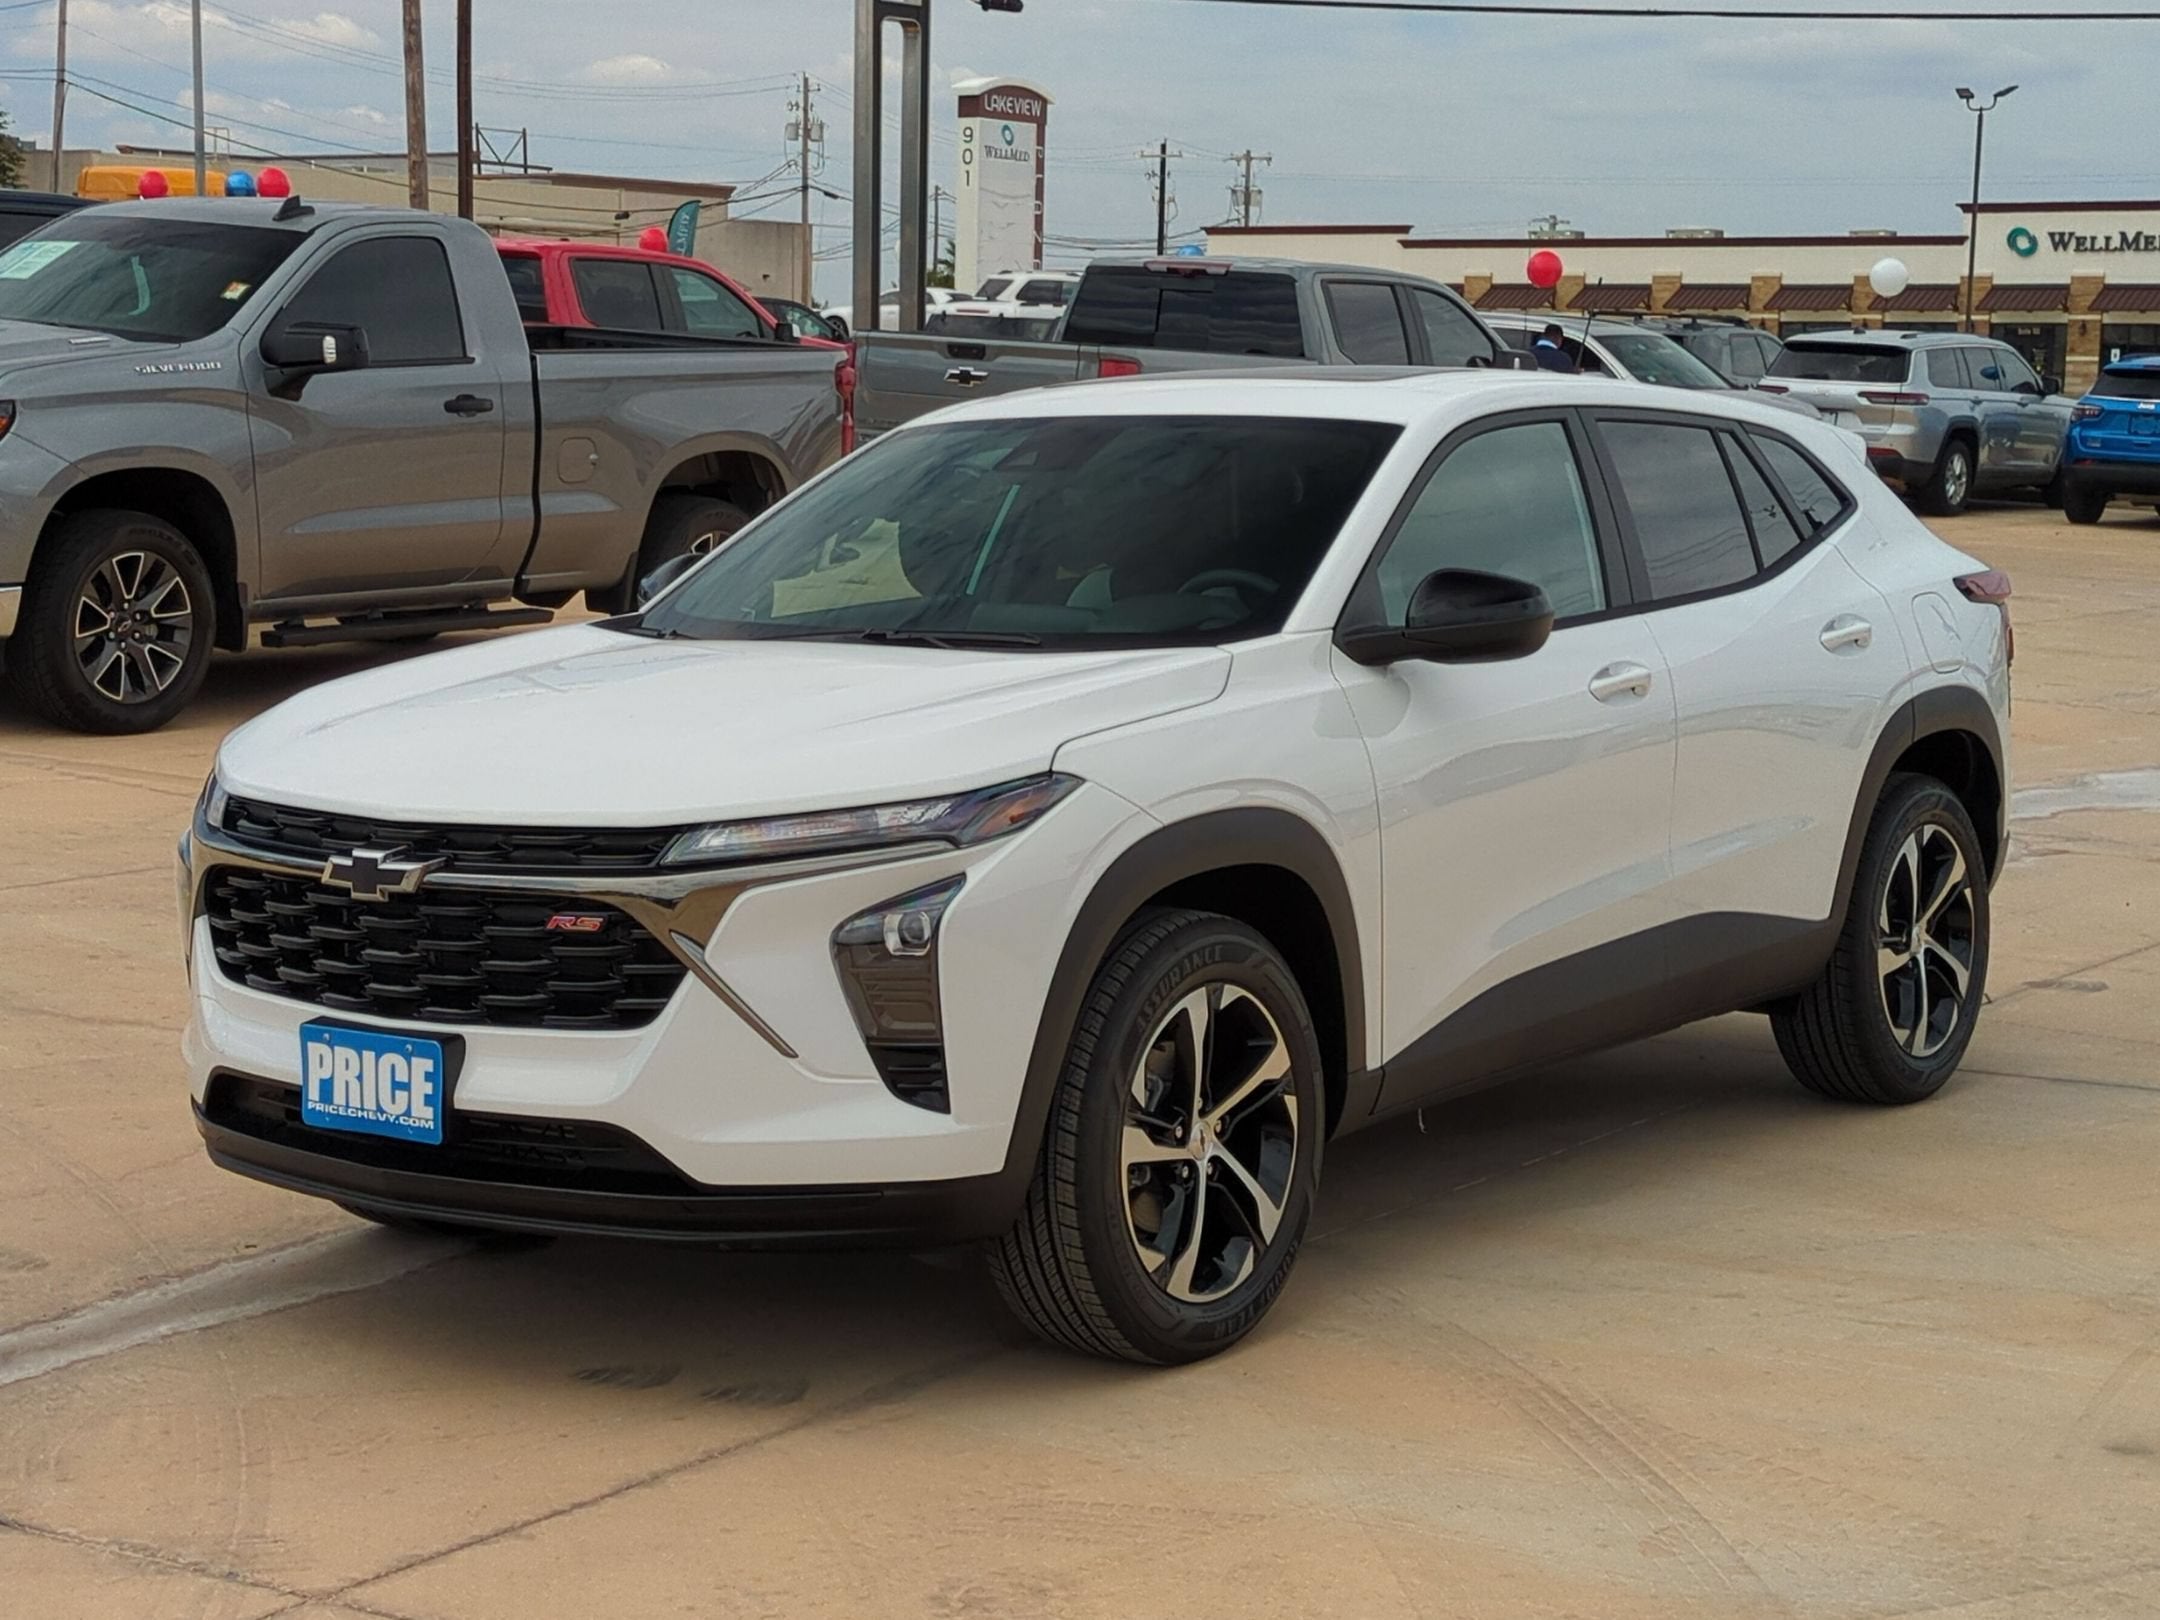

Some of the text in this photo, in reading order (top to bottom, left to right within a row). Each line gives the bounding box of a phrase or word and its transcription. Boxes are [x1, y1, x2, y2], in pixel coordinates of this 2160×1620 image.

[984, 94, 1042, 117] LAKEVIEW
[962, 127, 974, 187] 901
[2047, 231, 2160, 253] WELLME
[546, 915, 605, 932] RS
[1135, 944, 1225, 1033] ASSURANCE
[306, 1041, 434, 1120] PRICE
[307, 1100, 435, 1131] PRICECHEVY.COM
